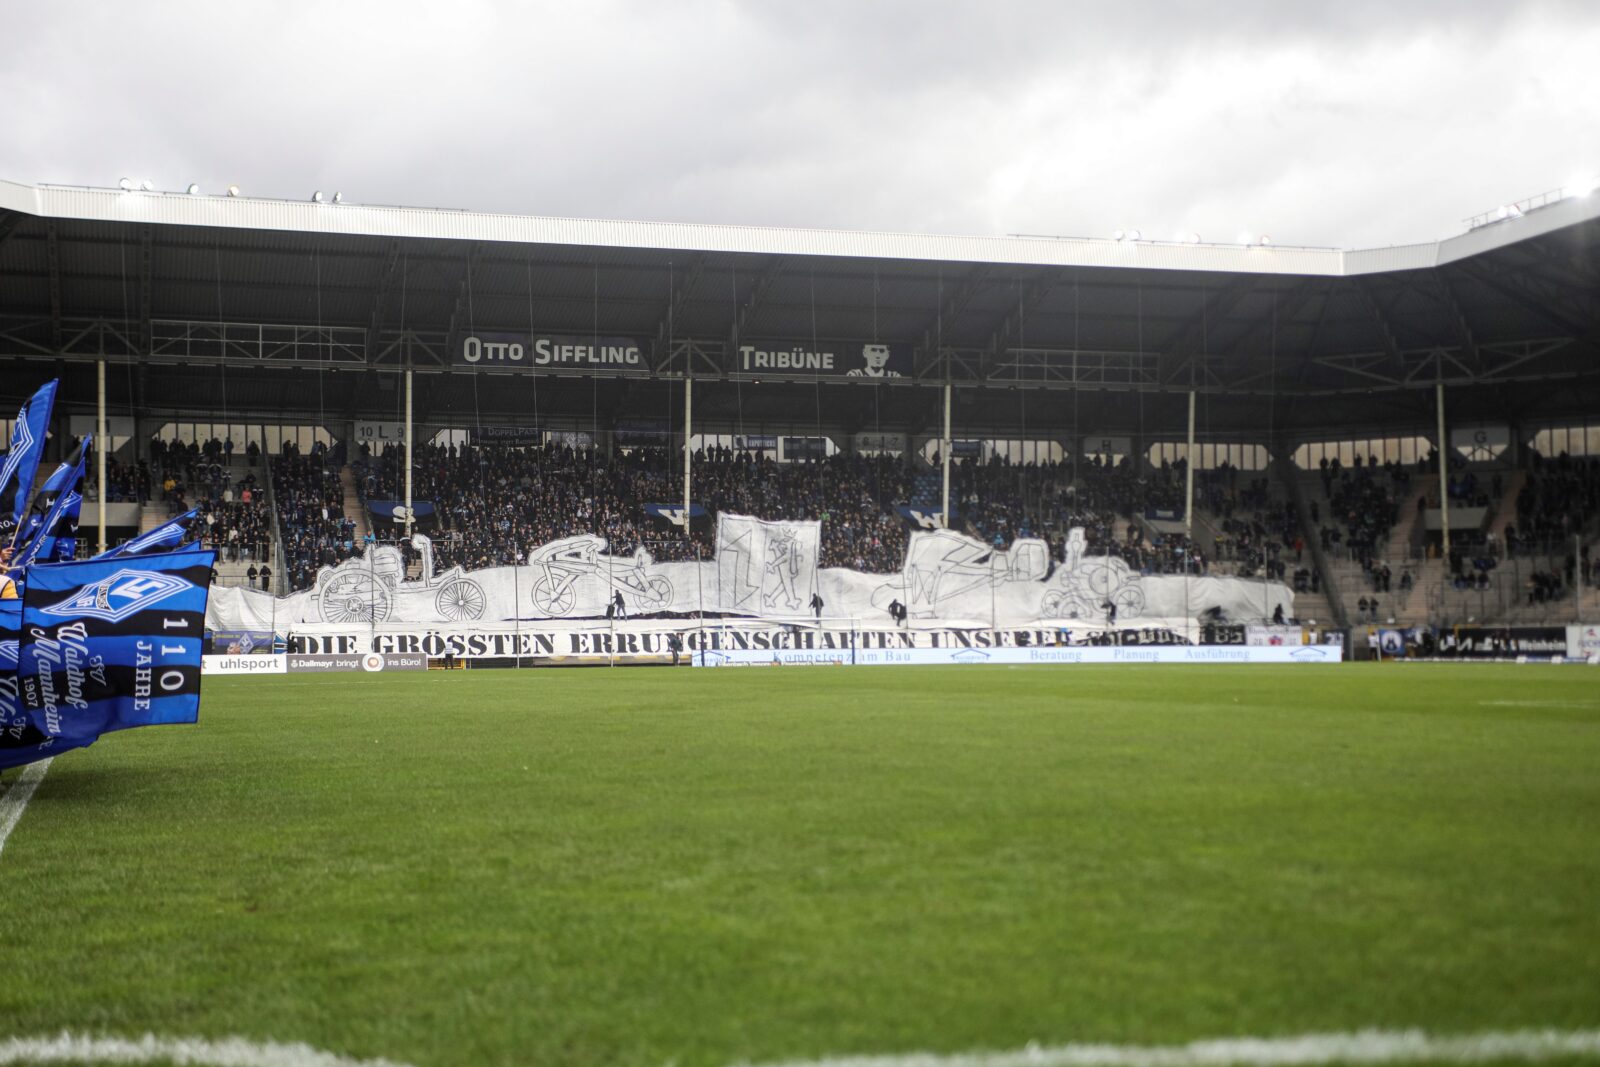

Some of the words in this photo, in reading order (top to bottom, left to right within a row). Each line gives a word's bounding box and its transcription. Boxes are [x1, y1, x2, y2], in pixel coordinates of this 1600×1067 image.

[360, 426, 373, 437] 10
[378, 425, 389, 438] L
[1474, 431, 1487, 444] G
[294, 635, 358, 654] DIE
[371, 631, 556, 656] GRÖSSTEN
[885, 651, 911, 662] Bau
[1030, 649, 1082, 662] Beratung
[1114, 649, 1160, 662] Planung
[1186, 648, 1250, 662] Ausführung
[57, 622, 88, 710] Waldhof
[220, 657, 279, 671] uhlsport
[299, 659, 333, 669] Dallmayr
[336, 658, 359, 669] bringt
[387, 658, 399, 666] ins
[30, 628, 62, 734] Mannheim
[134, 640, 152, 711] JAHRE
[24, 677, 38, 707] 1907
